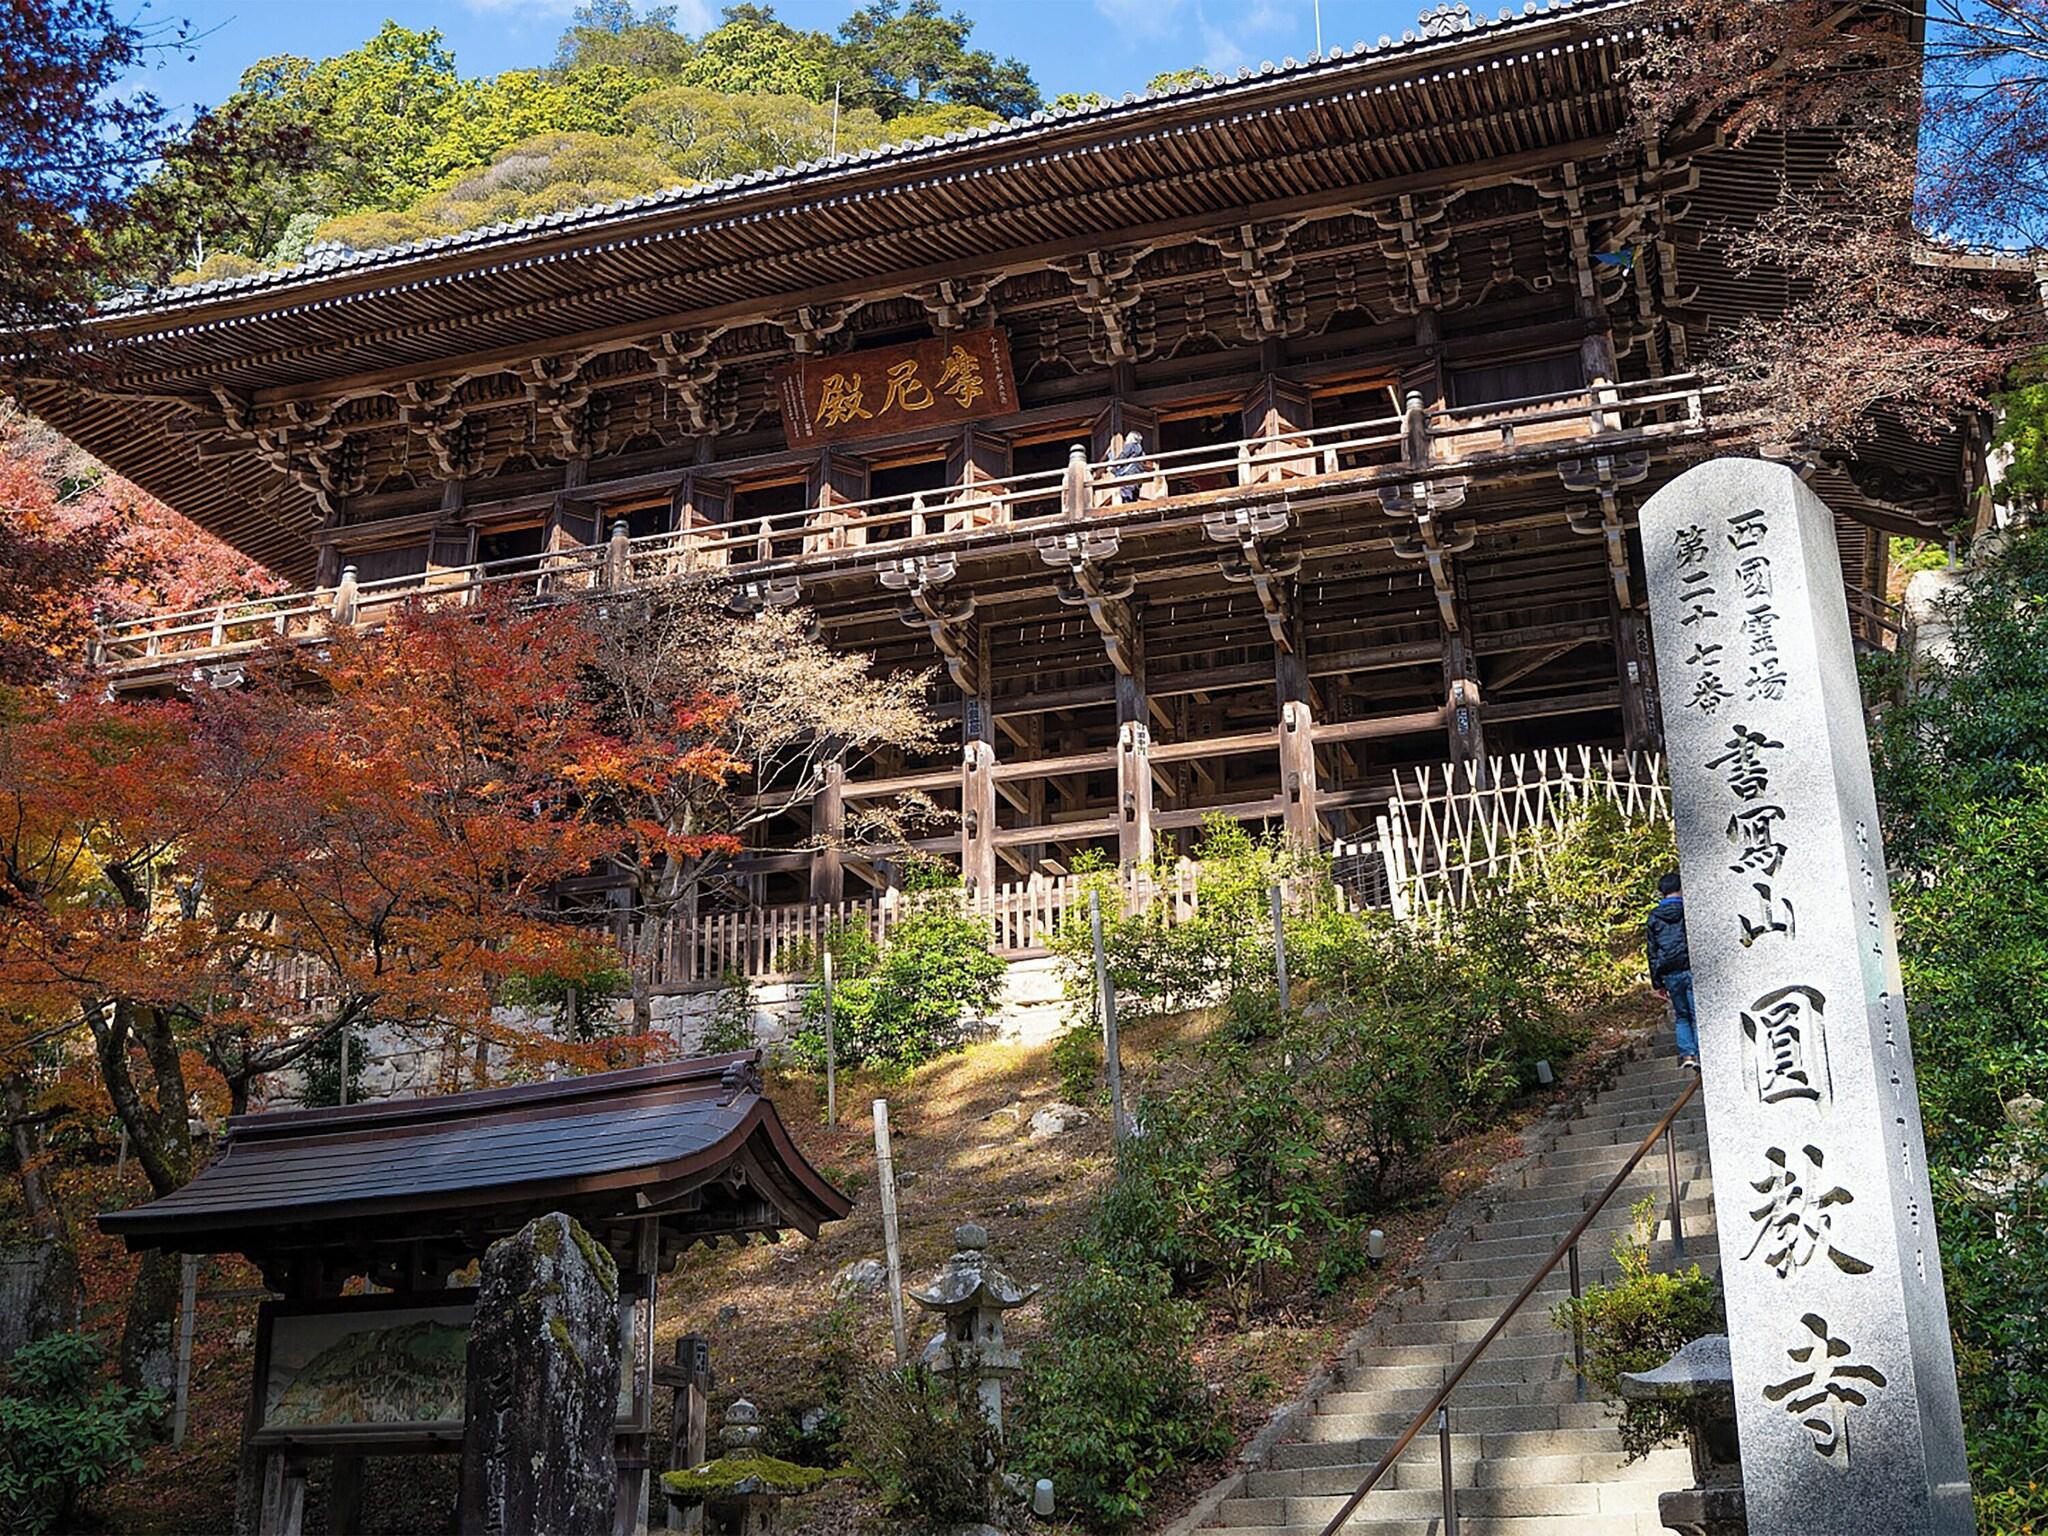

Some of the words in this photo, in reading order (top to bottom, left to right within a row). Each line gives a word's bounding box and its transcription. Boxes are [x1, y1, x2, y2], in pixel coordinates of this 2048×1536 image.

[815, 345, 984, 427] 摩尼殿
[1673, 524, 1735, 715] 第二十七番
